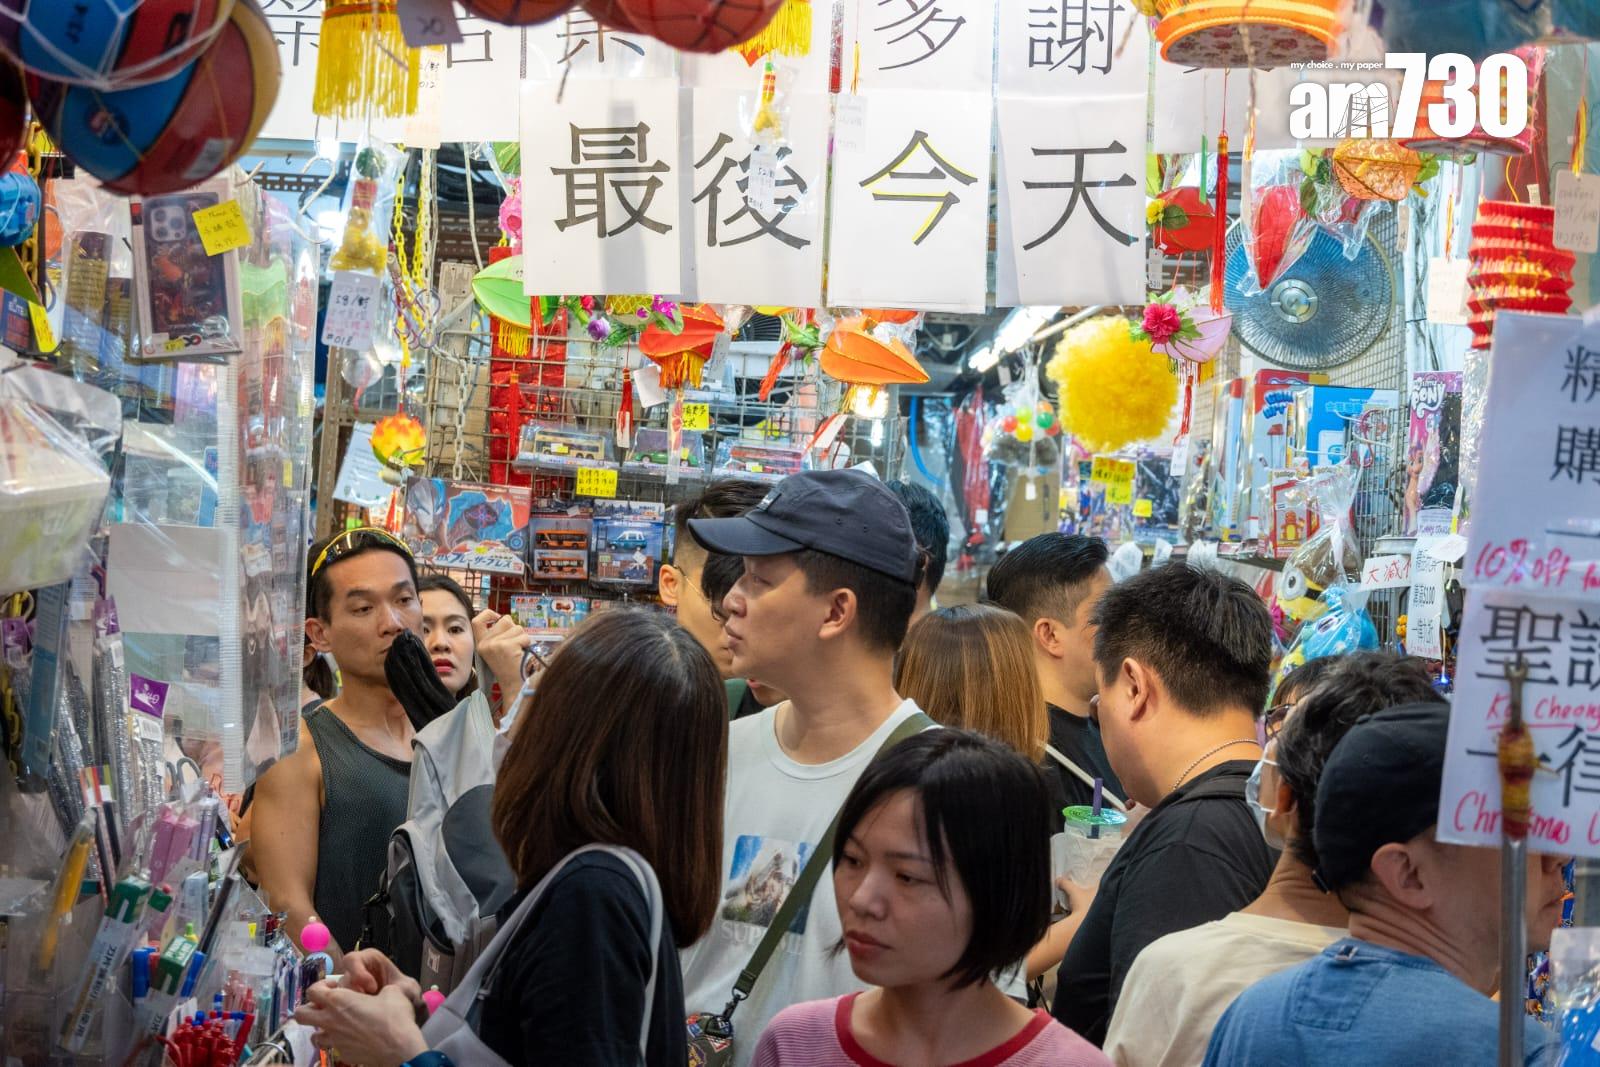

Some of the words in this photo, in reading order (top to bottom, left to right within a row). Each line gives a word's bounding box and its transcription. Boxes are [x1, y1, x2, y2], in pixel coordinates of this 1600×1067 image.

[550, 120, 1139, 251] 最後今天
[1474, 538, 1528, 585] 10%
